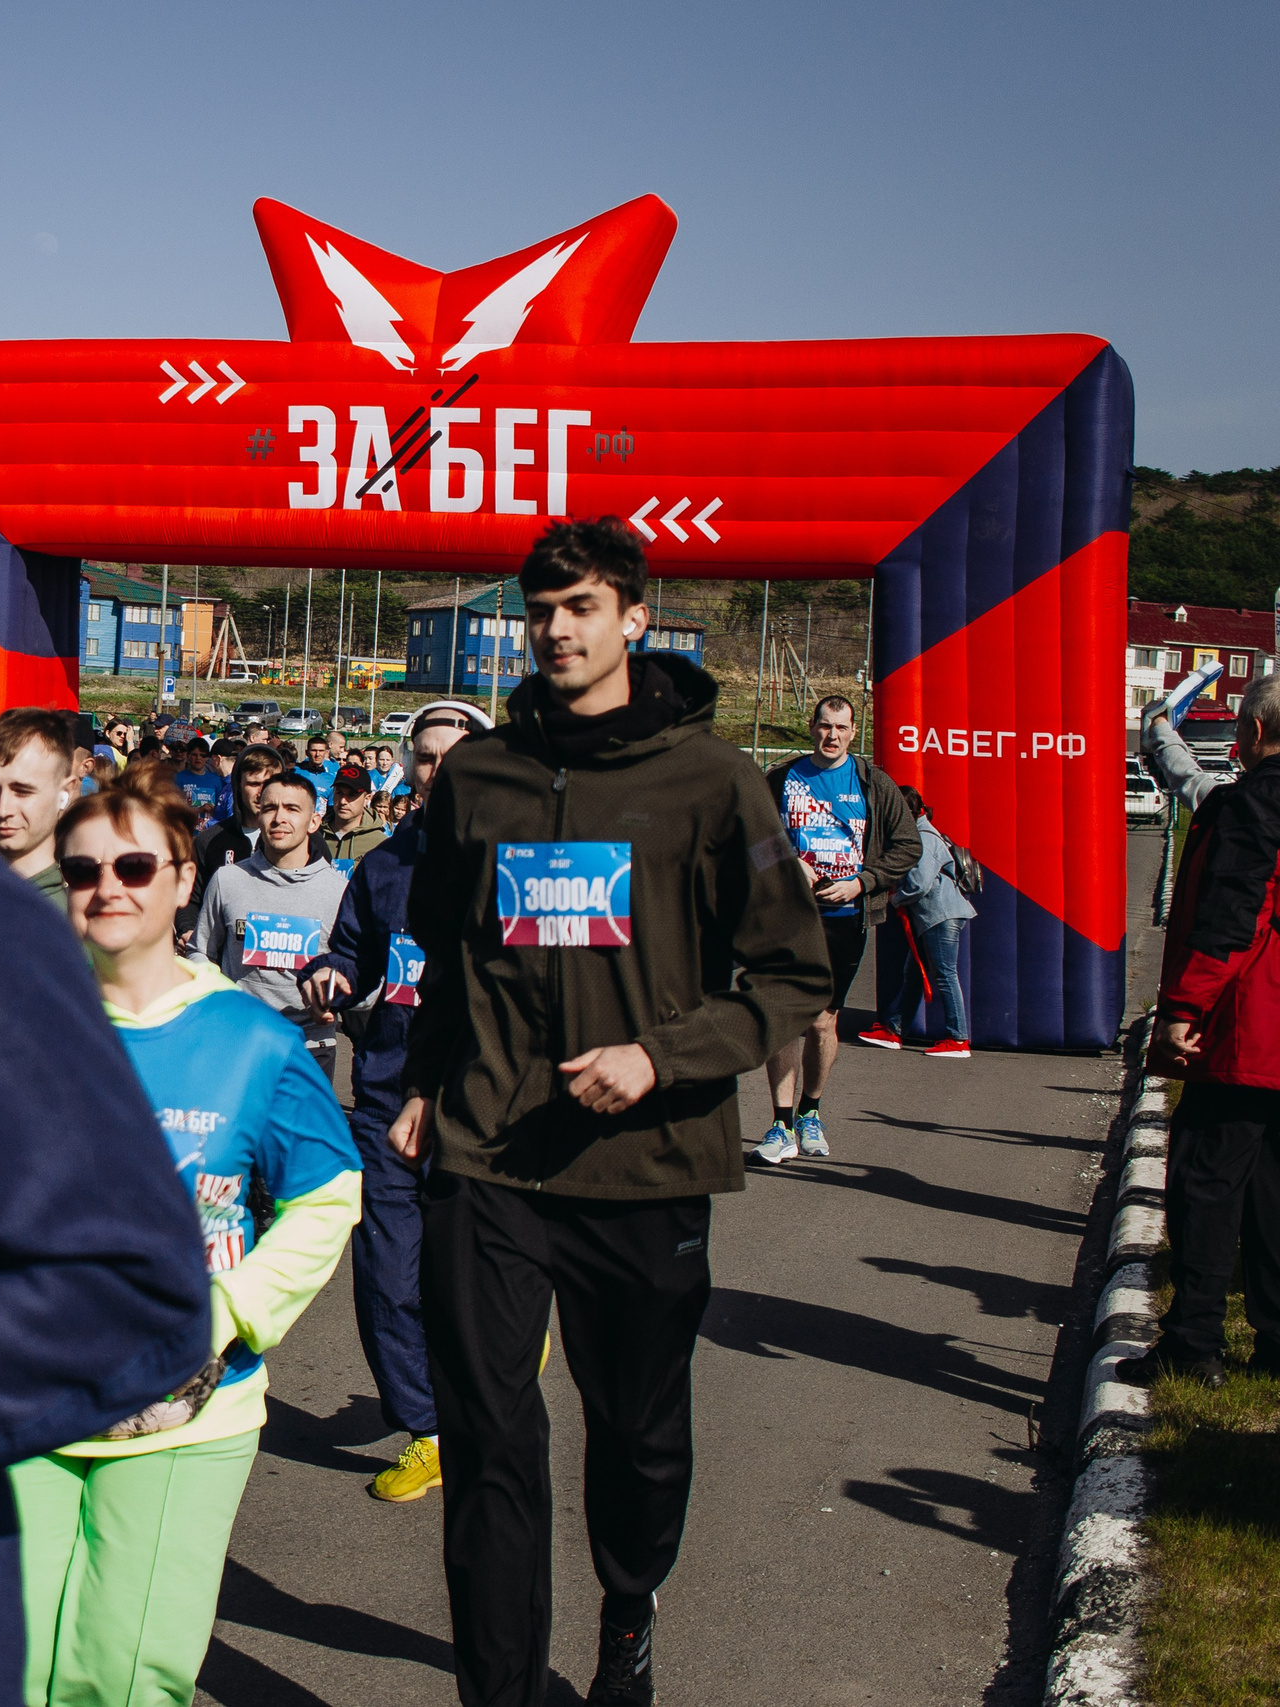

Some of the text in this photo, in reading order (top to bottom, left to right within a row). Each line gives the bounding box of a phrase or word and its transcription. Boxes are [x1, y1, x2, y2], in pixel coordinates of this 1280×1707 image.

[166, 678, 174, 692] P
[898, 725, 1086, 760] ЗАБЕГ.РФ
[524, 876, 608, 912] 30004
[260, 930, 303, 952] 30018
[536, 915, 590, 946] 10КМ
[266, 951, 295, 969] 10КМ
